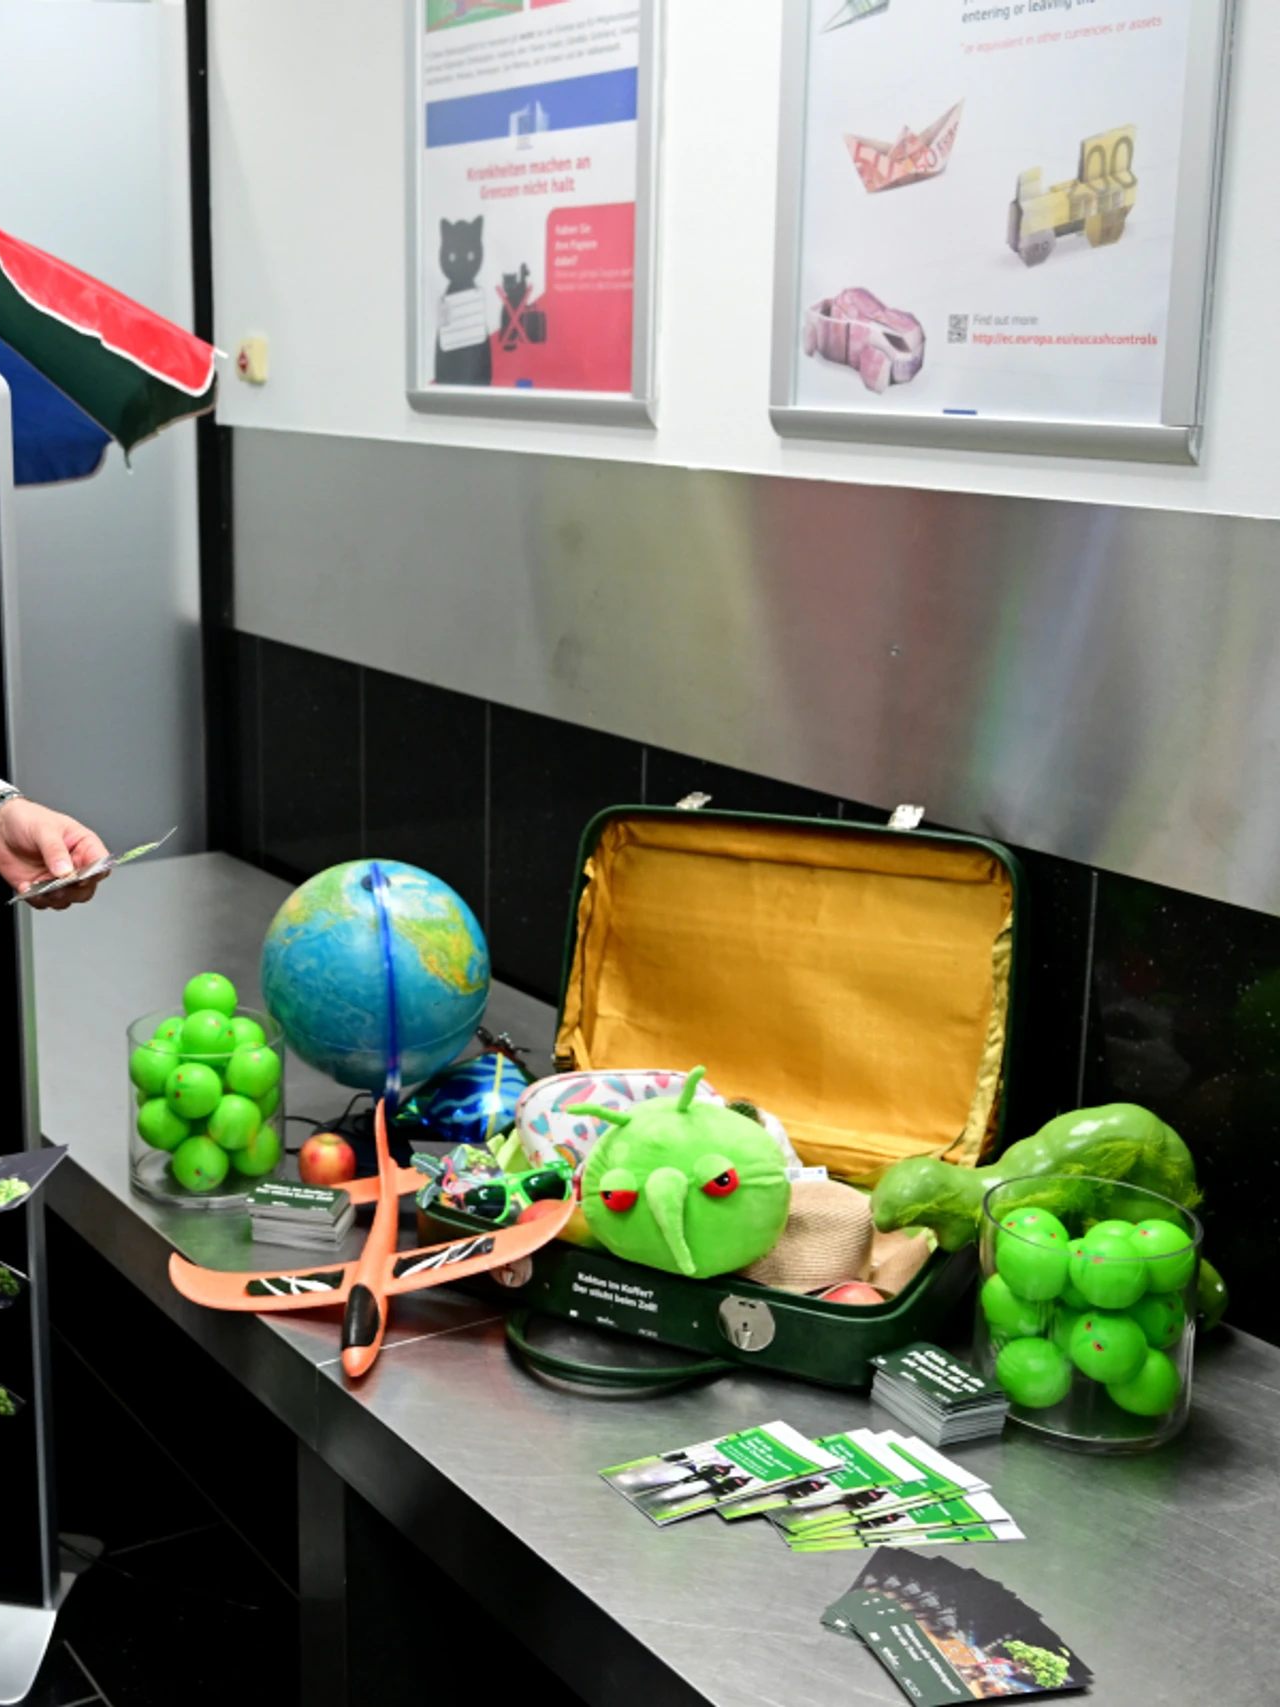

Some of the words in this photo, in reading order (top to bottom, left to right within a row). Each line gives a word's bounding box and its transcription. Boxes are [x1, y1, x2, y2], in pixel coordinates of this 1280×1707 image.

[962, 6, 1010, 23] entering
[1014, 4, 1025, 16] or
[1028, 0, 1072, 12] leaving
[977, 36, 1024, 53] equivalent
[1026, 35, 1035, 45] in
[1037, 31, 1062, 45] other
[1064, 24, 1114, 40] currencies
[1116, 22, 1126, 33] or
[1129, 16, 1163, 31] assets
[466, 162, 526, 182] Krankheiten
[529, 157, 572, 175] machen
[576, 156, 591, 170] an
[522, 179, 548, 196] nicht
[551, 176, 575, 193] halt
[973, 313, 993, 326] Find
[994, 314, 1009, 326] out
[578, 1271, 608, 1289] Kaktus
[620, 1283, 655, 1299] Koffer?
